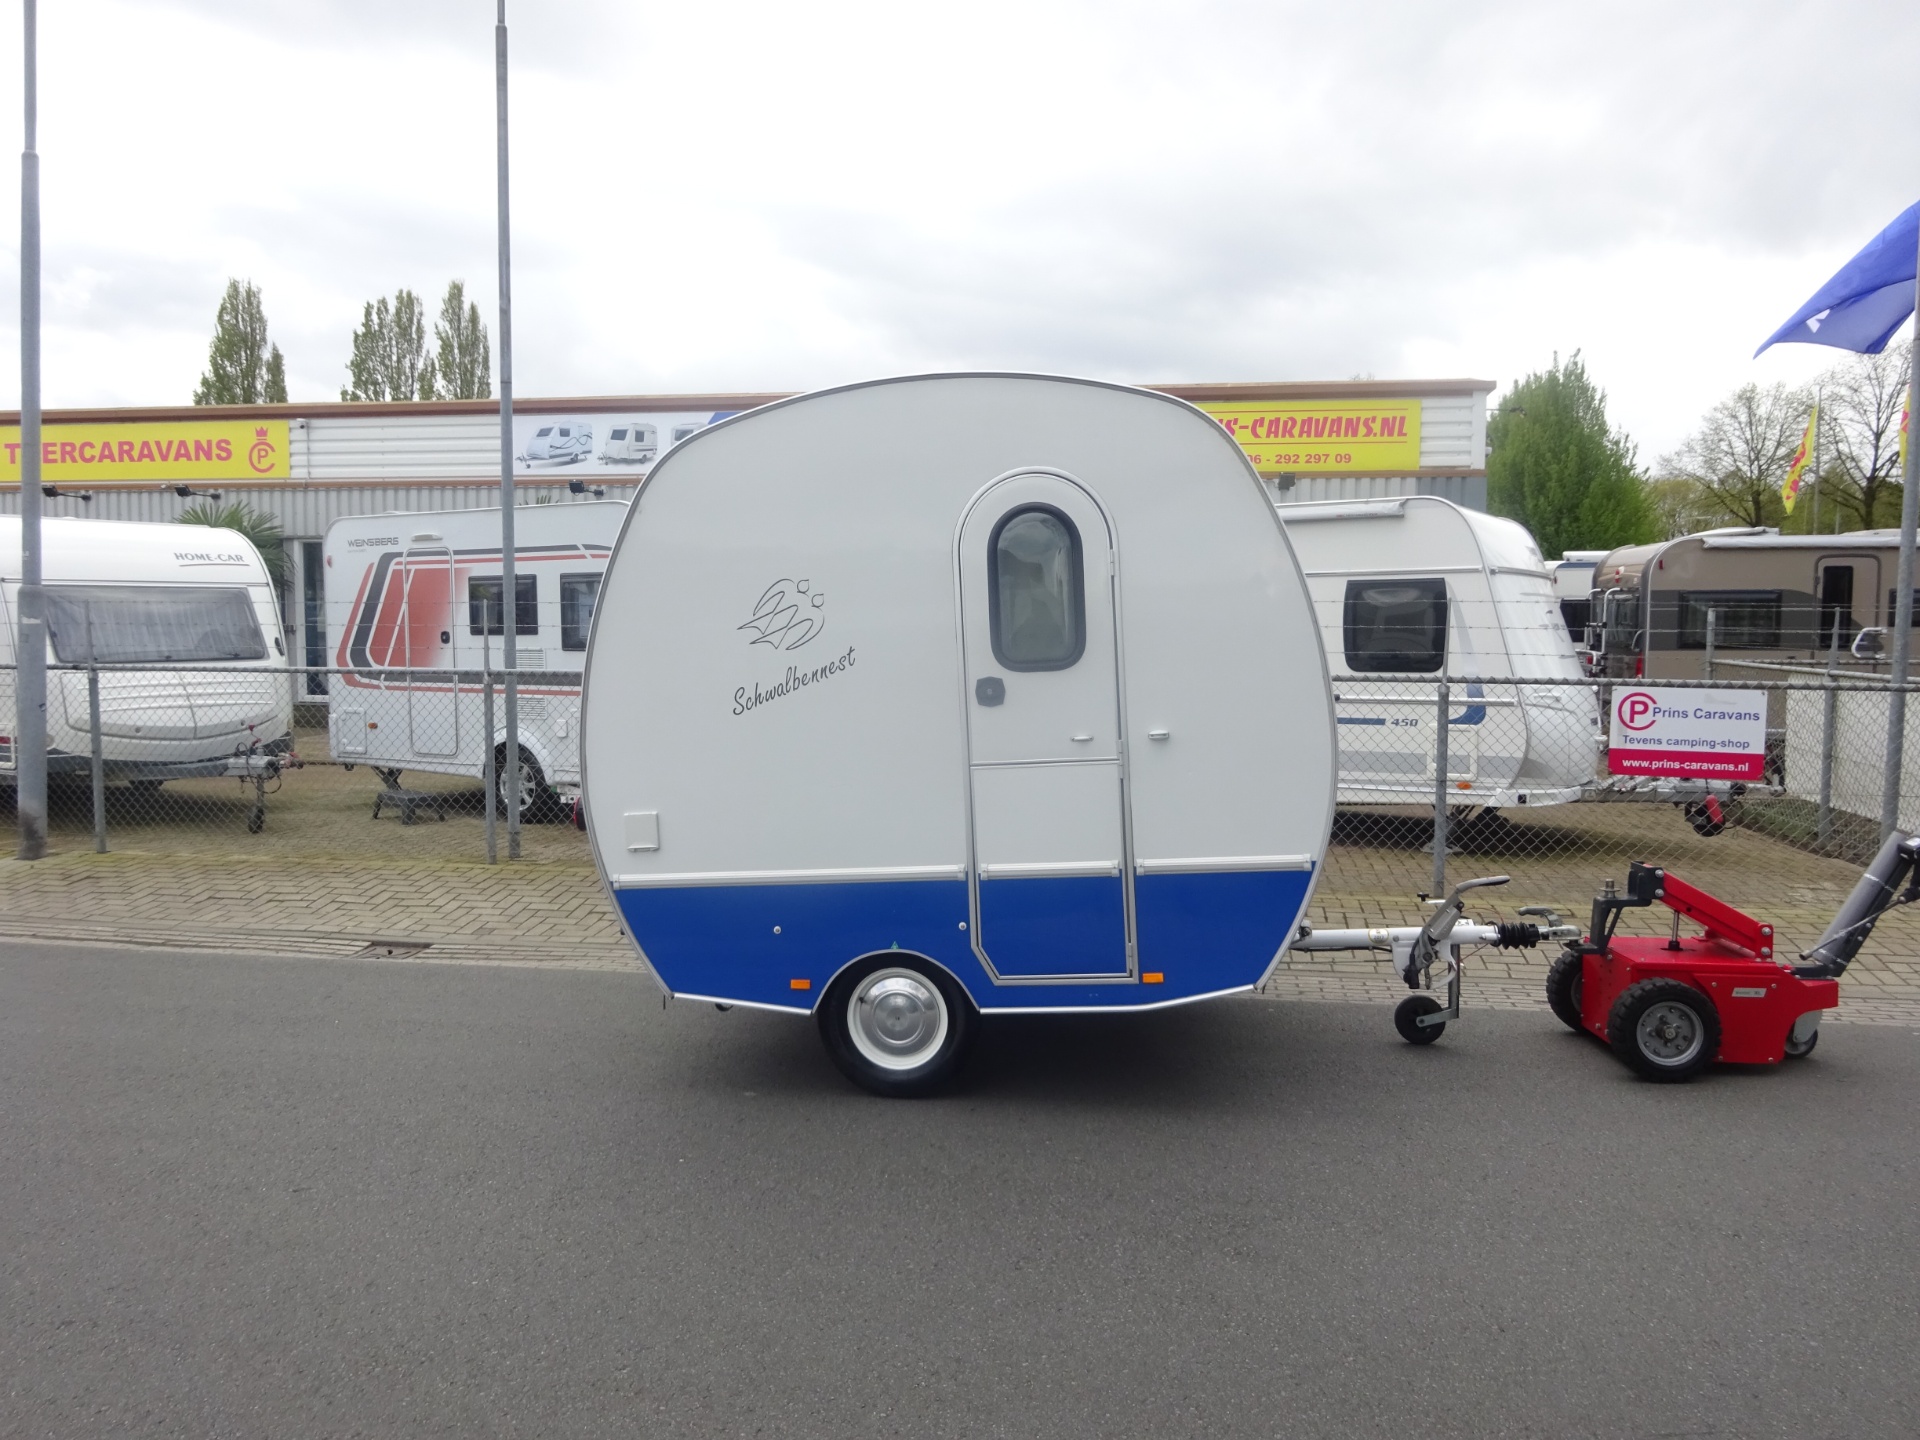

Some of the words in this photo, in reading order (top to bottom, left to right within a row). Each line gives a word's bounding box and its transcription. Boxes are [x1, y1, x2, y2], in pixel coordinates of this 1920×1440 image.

[1218, 415, 1408, 440] S-CARAVANS.NL
[4, 438, 233, 465] TERCARAVANS
[1274, 453, 1300, 464] 292
[1304, 453, 1330, 464] 297
[1334, 453, 1351, 464] 09
[347, 537, 399, 547] WEINSBERG
[173, 552, 245, 563] HOME-CAR
[733, 645, 856, 716] Schwalbennest
[1651, 706, 1689, 719] Prins
[1693, 708, 1760, 721] Caravans
[1390, 718, 1419, 727] 450
[1622, 734, 1663, 746] Tevens
[1666, 736, 1750, 750] camping-shop
[1622, 758, 1749, 772] www.prins-caravans.nl
